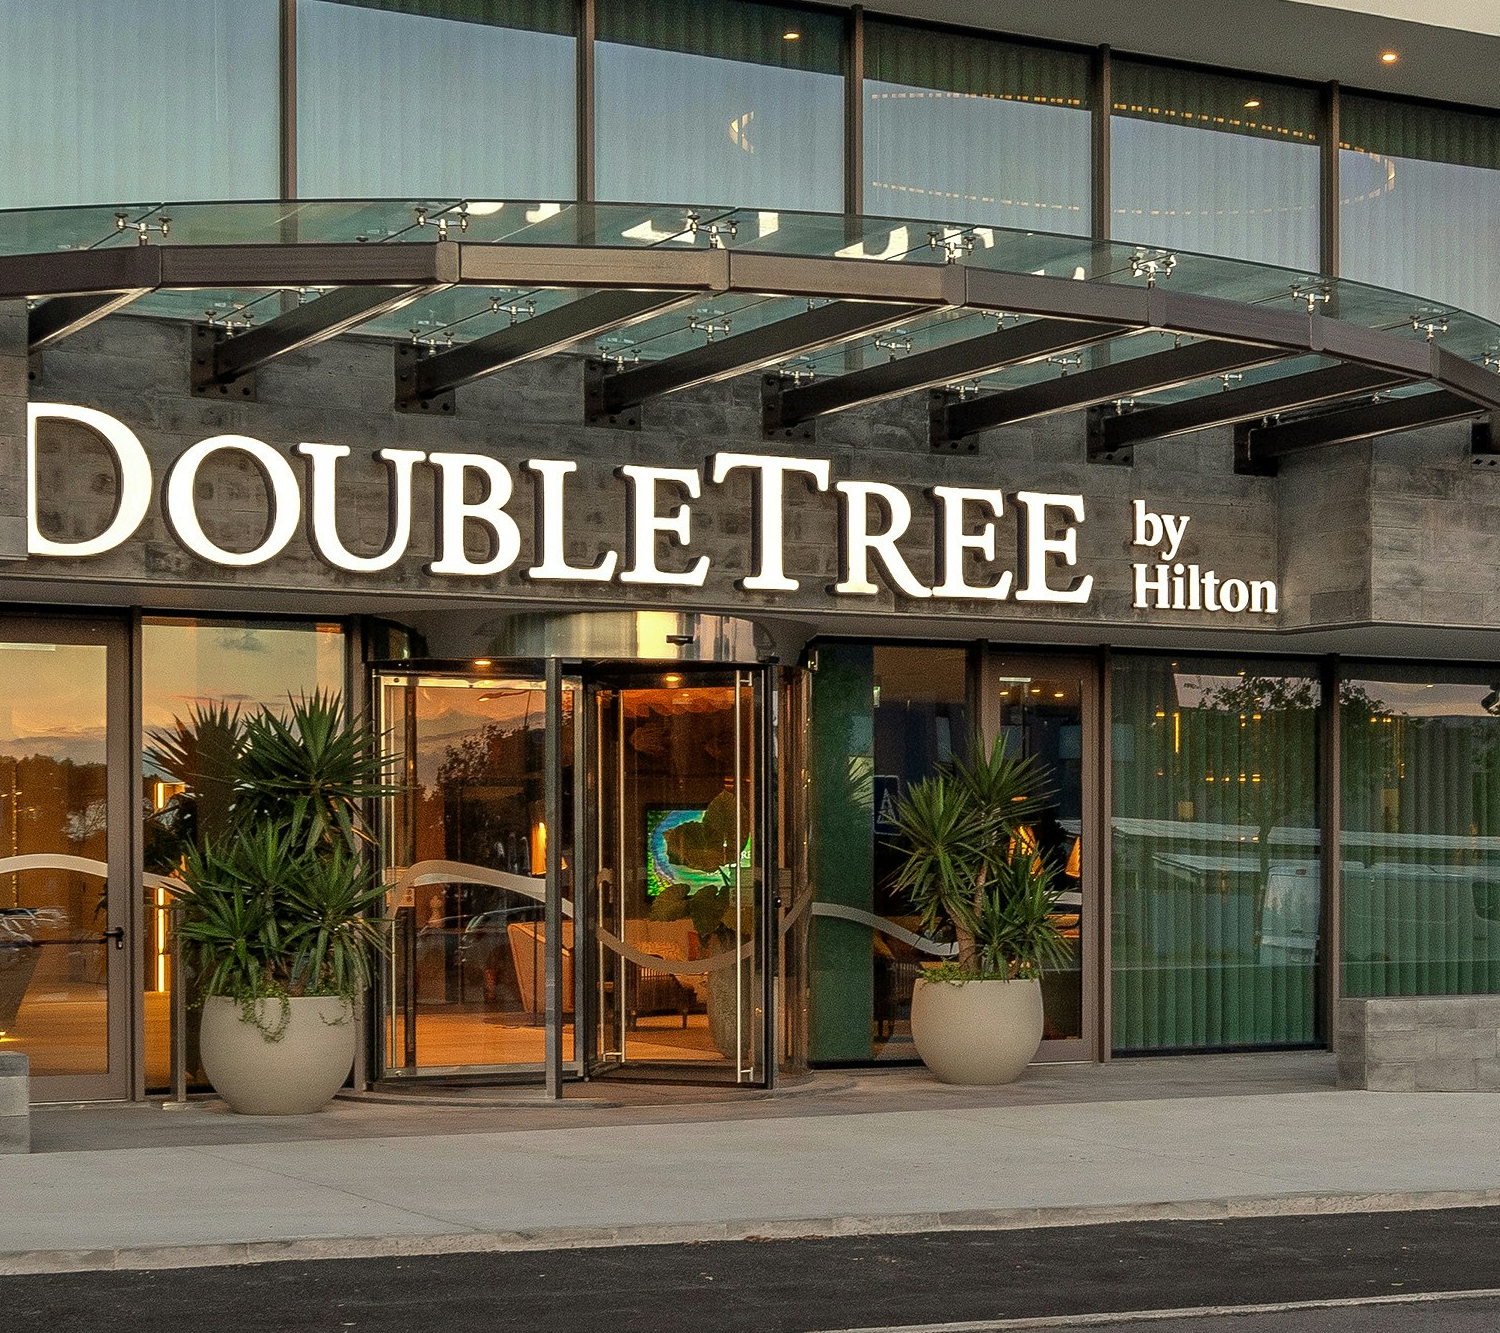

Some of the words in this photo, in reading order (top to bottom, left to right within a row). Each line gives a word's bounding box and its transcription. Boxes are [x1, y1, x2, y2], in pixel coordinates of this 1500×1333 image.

[27, 402, 1094, 604] DOUBLETREE
[1133, 499, 1191, 561] by
[1133, 562, 1279, 614] Hilton
